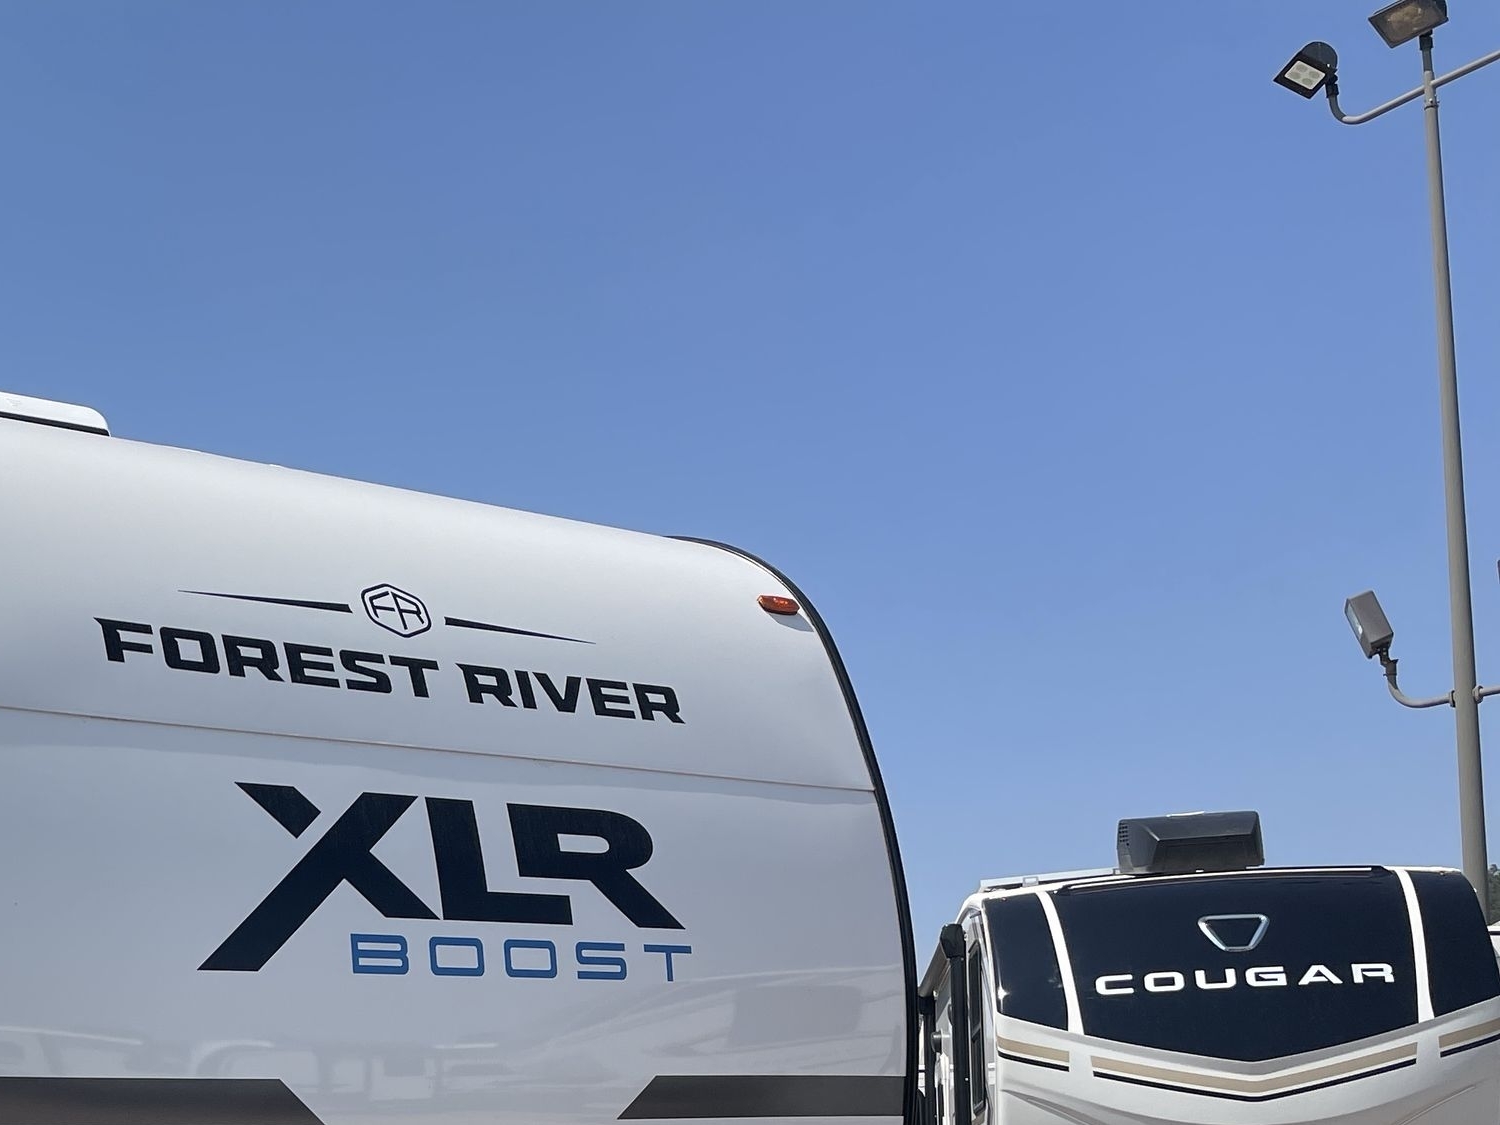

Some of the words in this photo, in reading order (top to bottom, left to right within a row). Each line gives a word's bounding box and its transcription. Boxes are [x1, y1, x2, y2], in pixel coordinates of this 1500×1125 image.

[93, 616, 440, 699] FOREST
[455, 662, 687, 724] RIVER
[196, 781, 687, 972] XLR
[350, 932, 693, 982] BOOST
[1095, 961, 1396, 997] COUGAR
